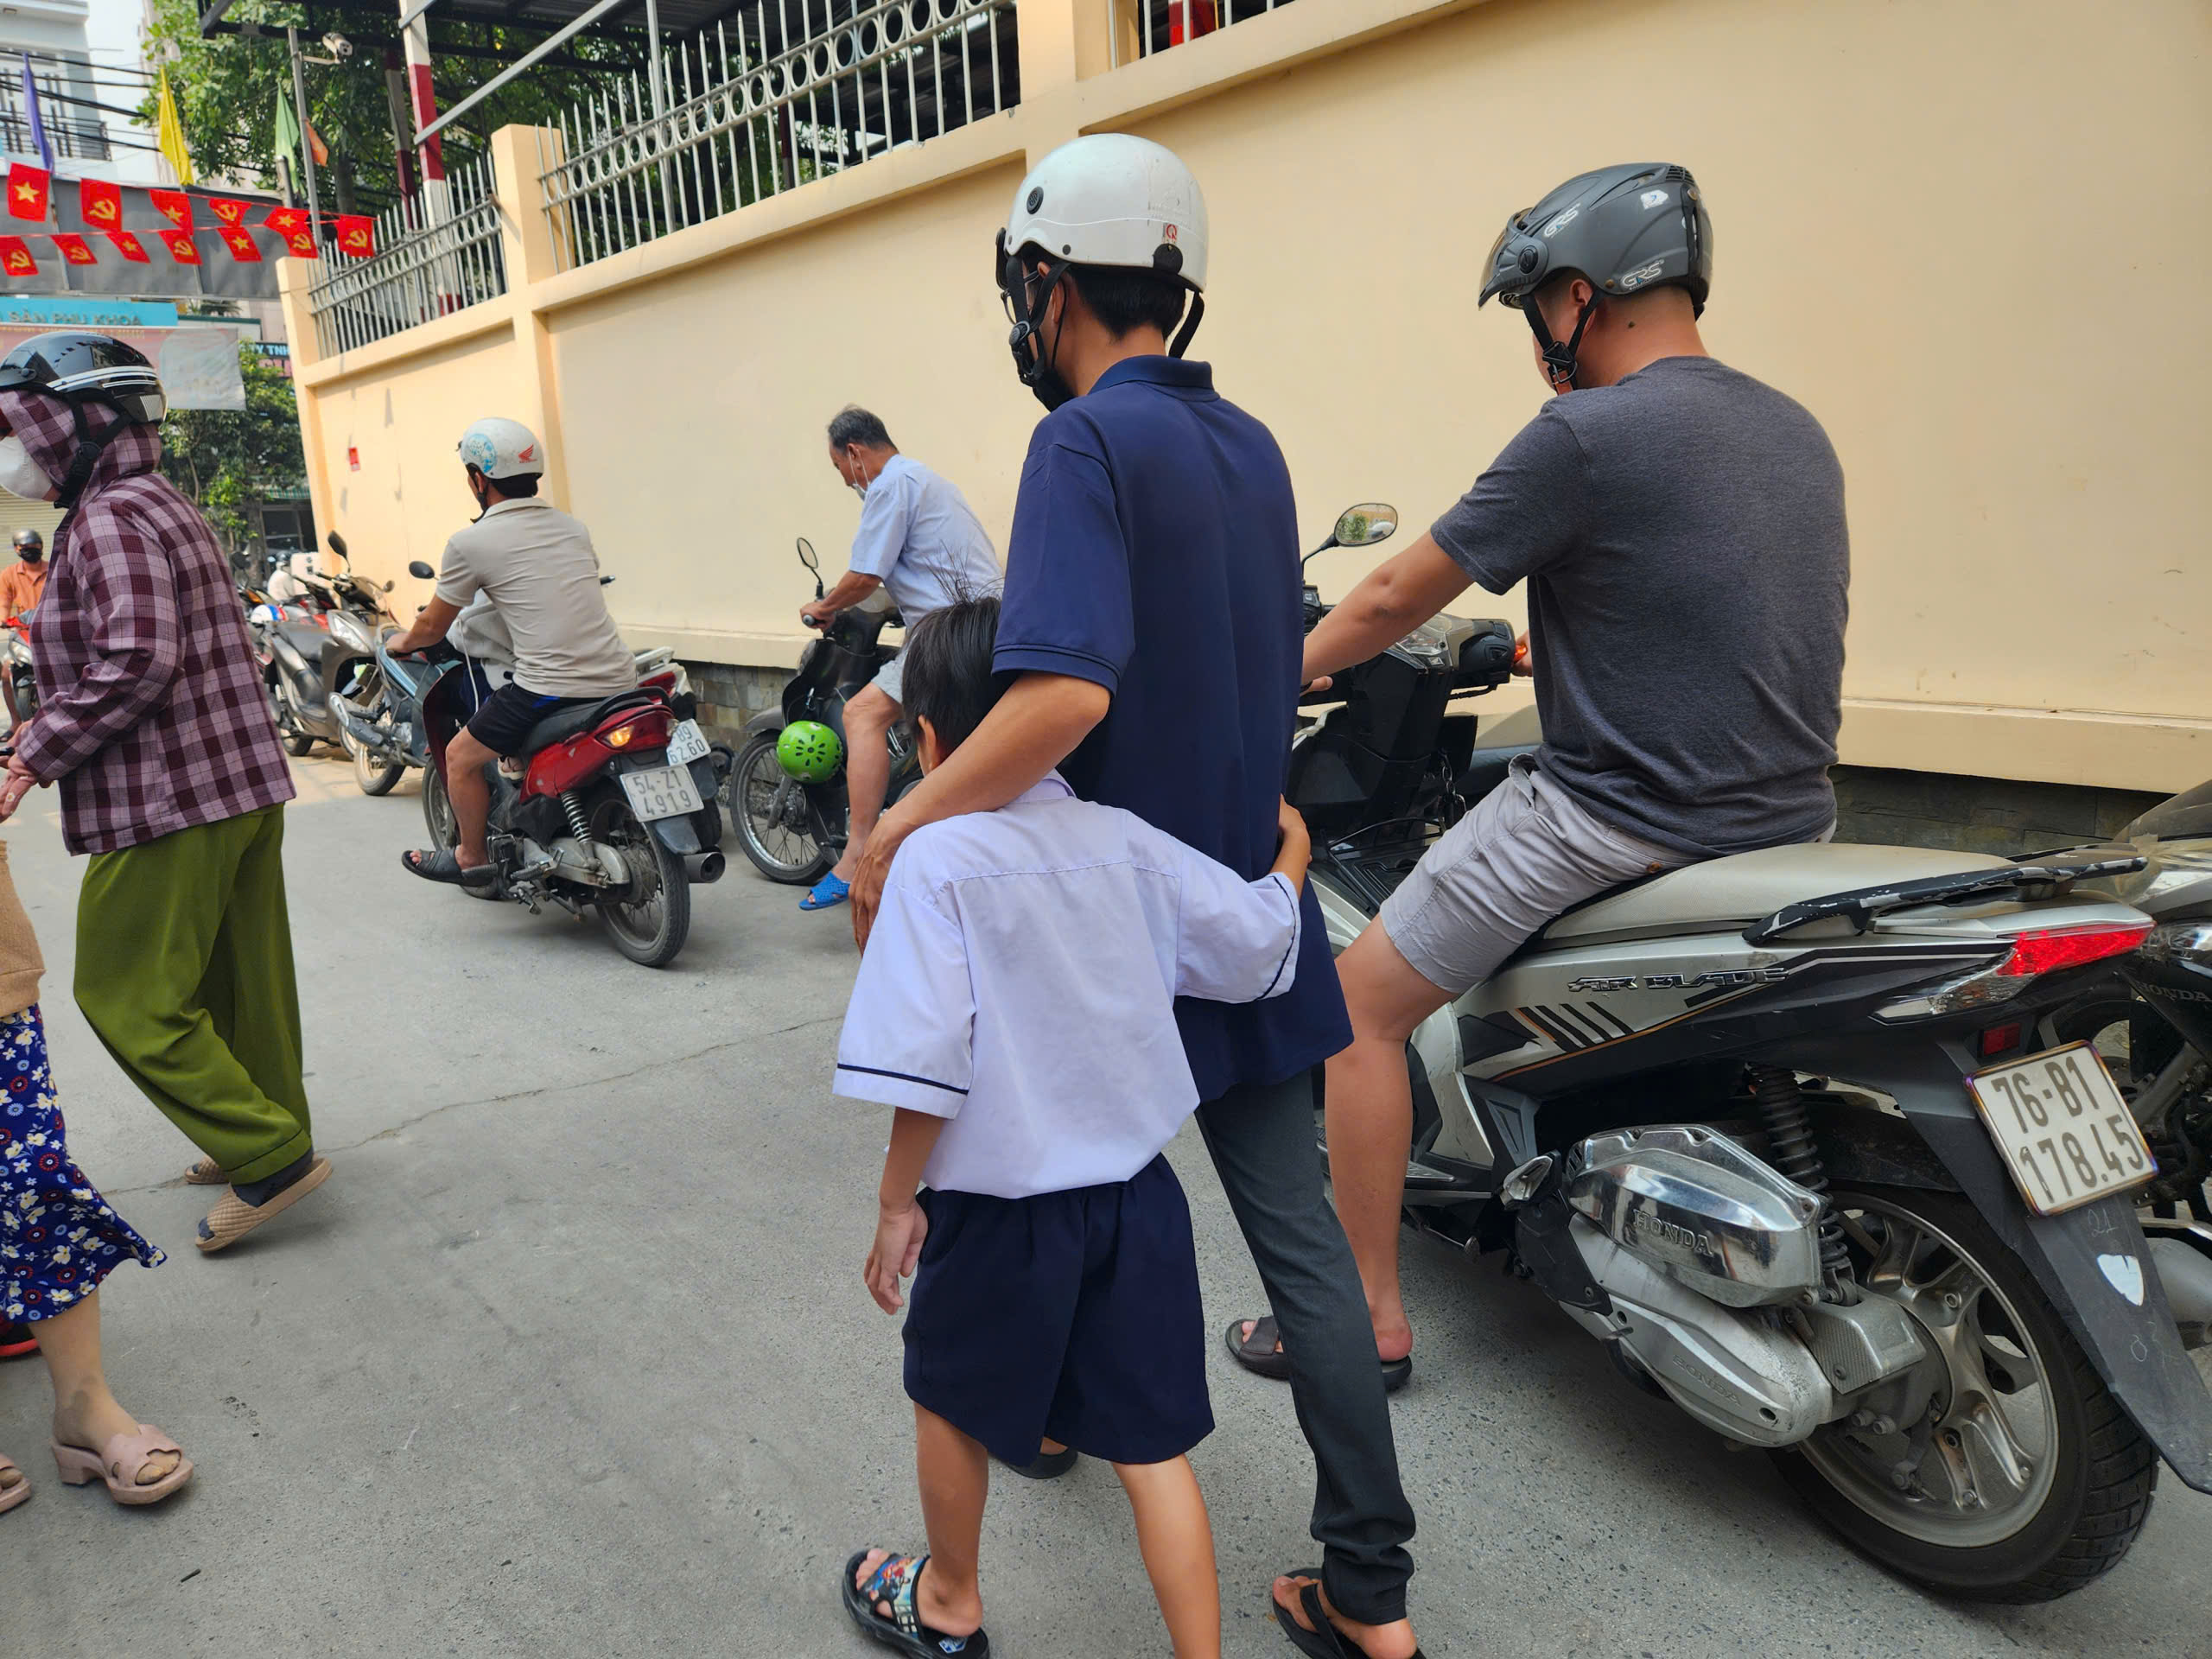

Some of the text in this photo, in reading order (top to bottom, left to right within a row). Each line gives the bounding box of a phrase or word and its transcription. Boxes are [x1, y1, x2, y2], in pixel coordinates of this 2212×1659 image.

[1622, 260, 1663, 287] GRS
[644, 790, 692, 815] 4919
[1991, 1056, 2100, 1133] 76-B1
[2019, 1114, 2144, 1204] 178.45
[1633, 1209, 1713, 1257] HONDA
